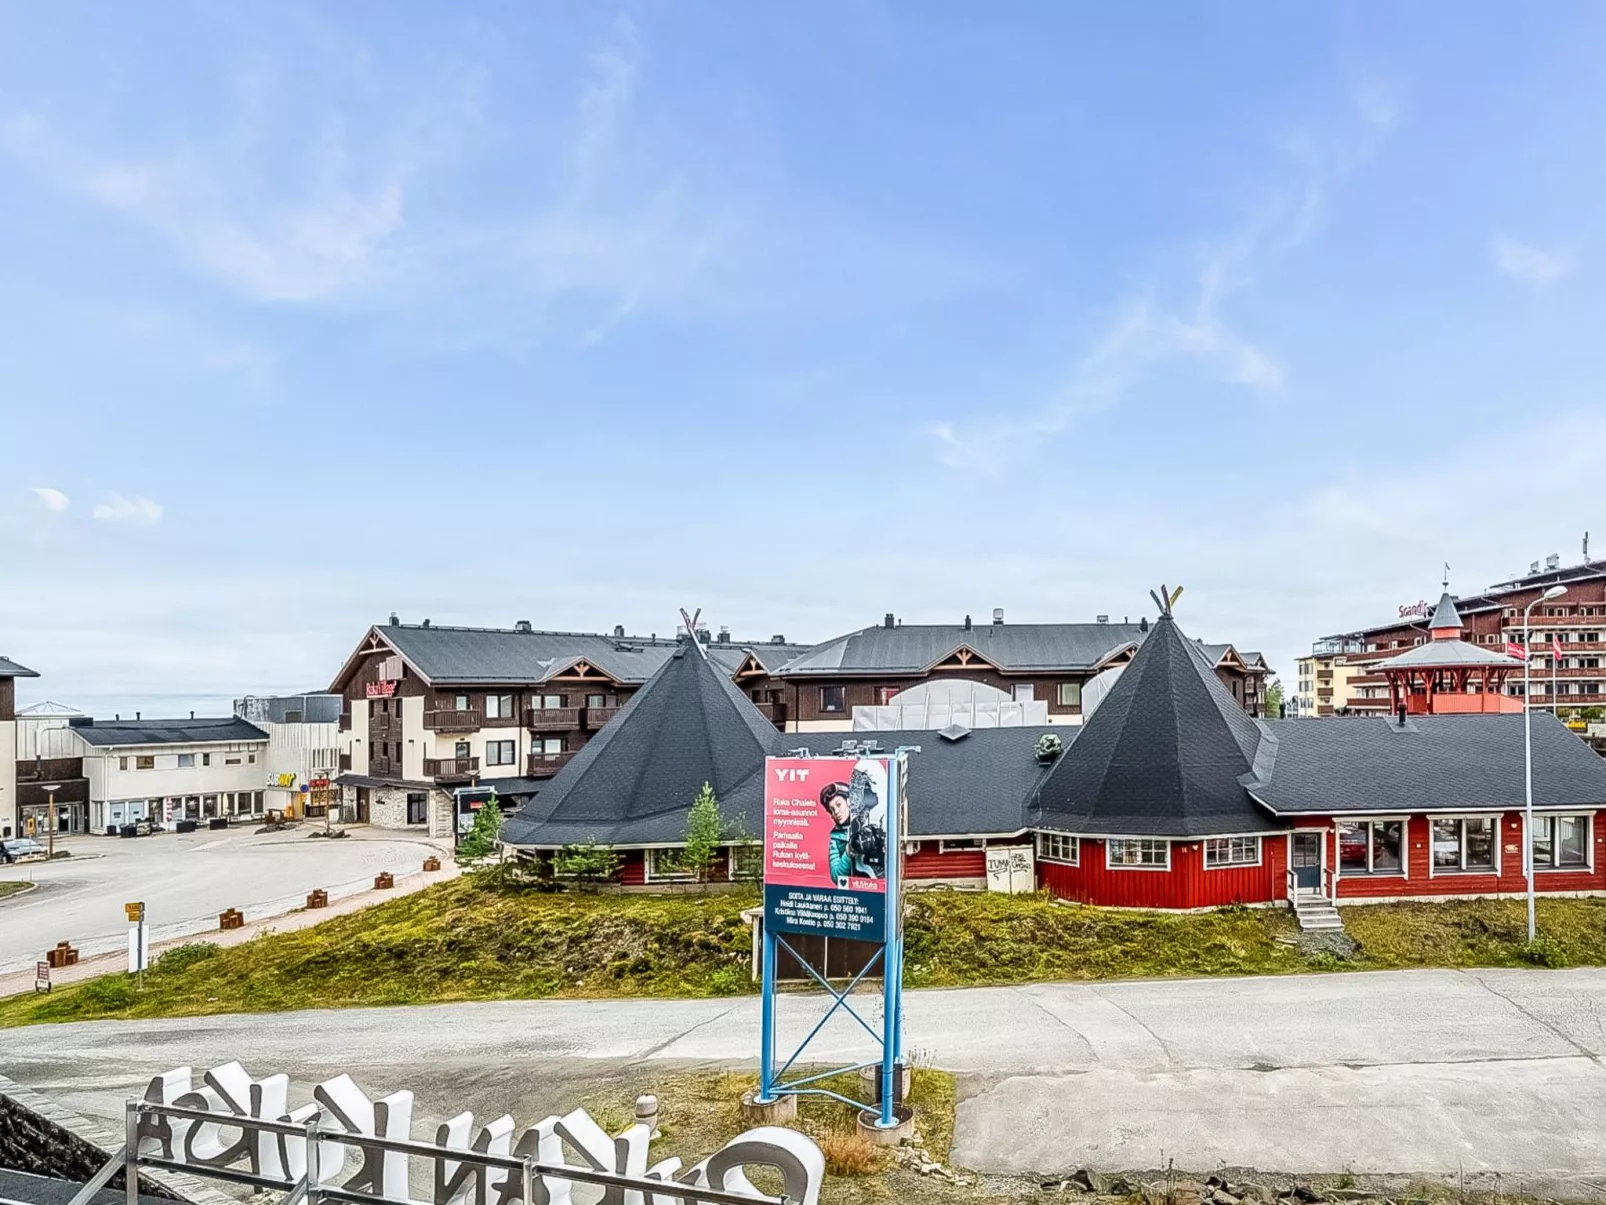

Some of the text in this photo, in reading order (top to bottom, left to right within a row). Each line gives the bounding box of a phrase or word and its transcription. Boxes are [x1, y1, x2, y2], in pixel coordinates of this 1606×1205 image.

[1398, 600, 1428, 618] Scandic
[774, 768, 809, 782] YIT
[266, 773, 296, 787] SUBWAY
[773, 797, 817, 807] Ruka Chalets
[773, 808, 818, 817] loma-asunnot
[772, 850, 793, 859] Rukan
[805, 893, 812, 901] JA
[830, 904, 842, 912] 050
[823, 920, 834, 928] 050
